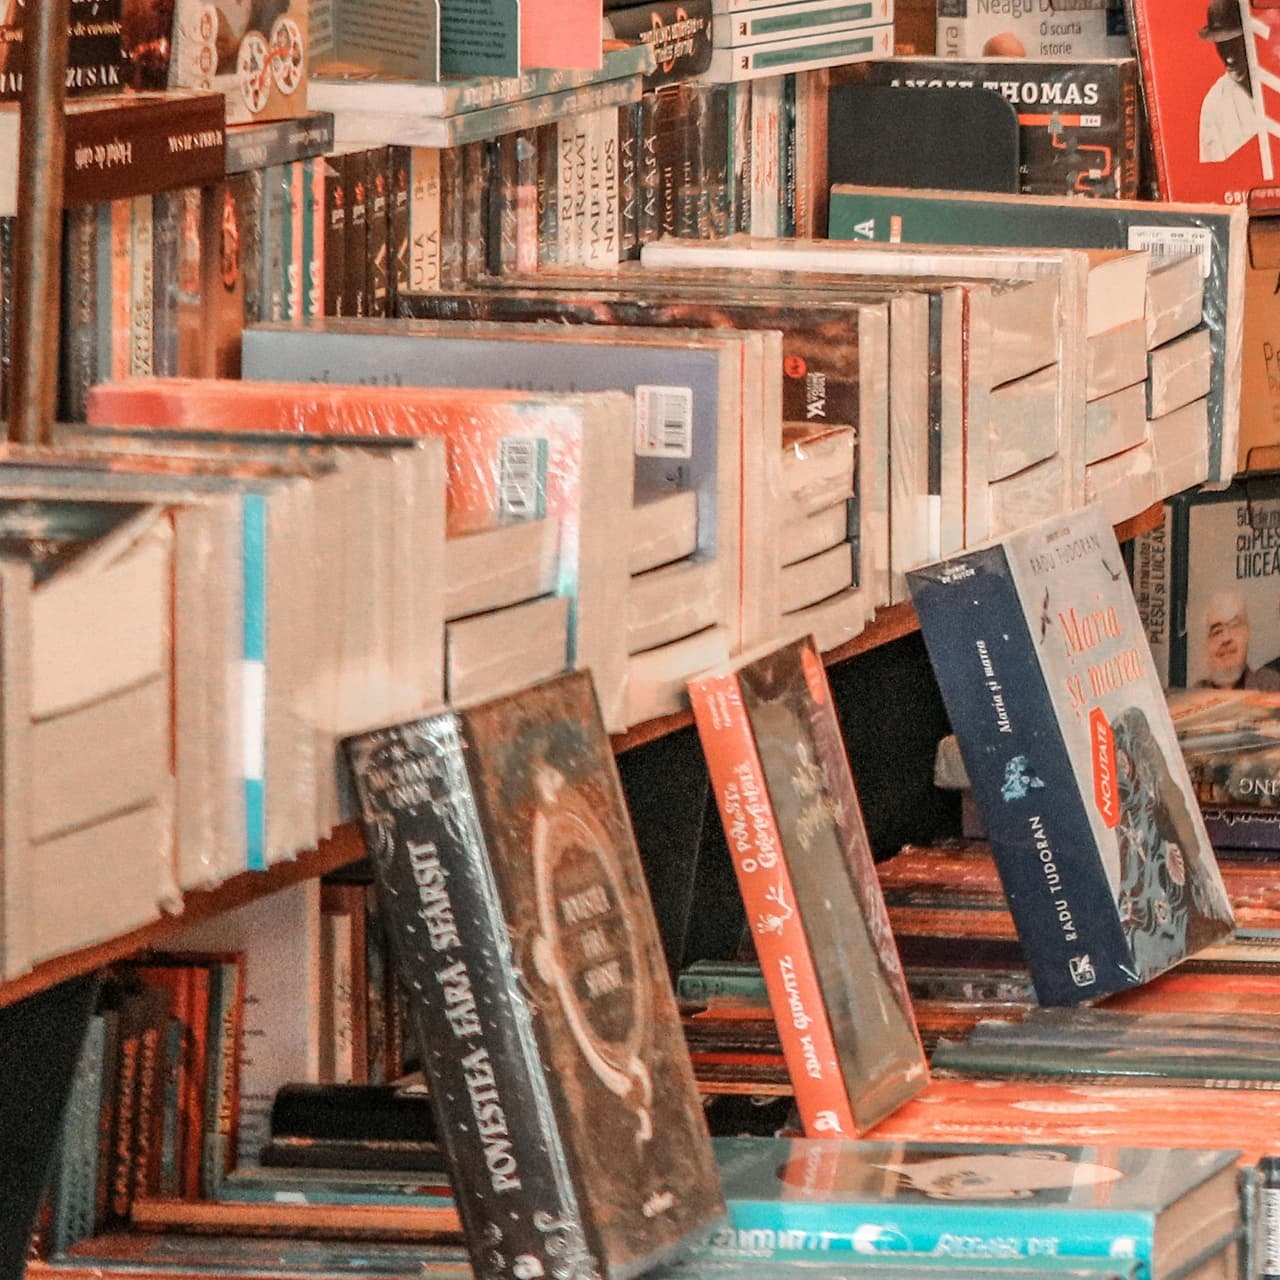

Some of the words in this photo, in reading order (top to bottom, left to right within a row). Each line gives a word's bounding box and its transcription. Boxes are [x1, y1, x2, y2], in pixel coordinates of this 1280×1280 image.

[1040, 23, 1048, 36] O
[1040, 42, 1072, 56] istorie
[603, 139, 616, 254] NEMILOS
[621, 138, 635, 220] ACASĂ
[642, 135, 657, 217] ACASĂ
[1029, 554, 1056, 576] RADU
[1056, 535, 1101, 568] TUDORAN
[1057, 593, 1121, 662] Maria
[1151, 599, 1164, 644] PLEȘU
[974, 639, 994, 675] marea
[1087, 641, 1145, 696] marea
[992, 693, 1012, 734] Maria
[1096, 721, 1115, 819] NOUTATE
[740, 857, 758, 873] O
[1028, 816, 1067, 895] TUDORAN
[1053, 900, 1078, 944] RADU
[799, 1035, 822, 1081] ADAM
[462, 1048, 521, 1194] POVESTEA
